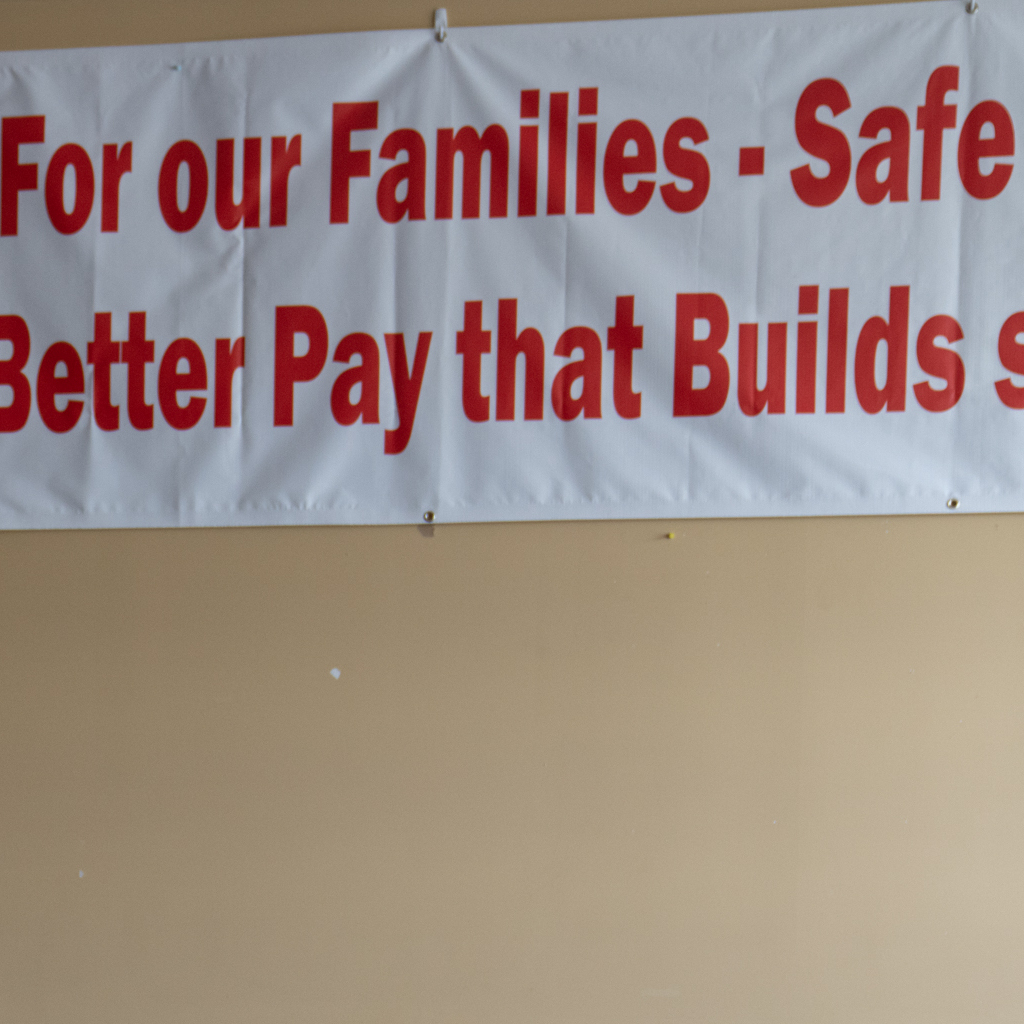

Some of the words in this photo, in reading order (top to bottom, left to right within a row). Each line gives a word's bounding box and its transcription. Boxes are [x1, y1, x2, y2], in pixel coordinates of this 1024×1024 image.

[0, 114, 132, 237] For
[157, 133, 302, 234] our
[329, 86, 711, 226] Families
[738, 146, 765, 176] -
[789, 64, 1016, 209] Safe
[272, 304, 431, 456] Pay
[455, 295, 643, 424] that
[672, 285, 965, 419] Builds
